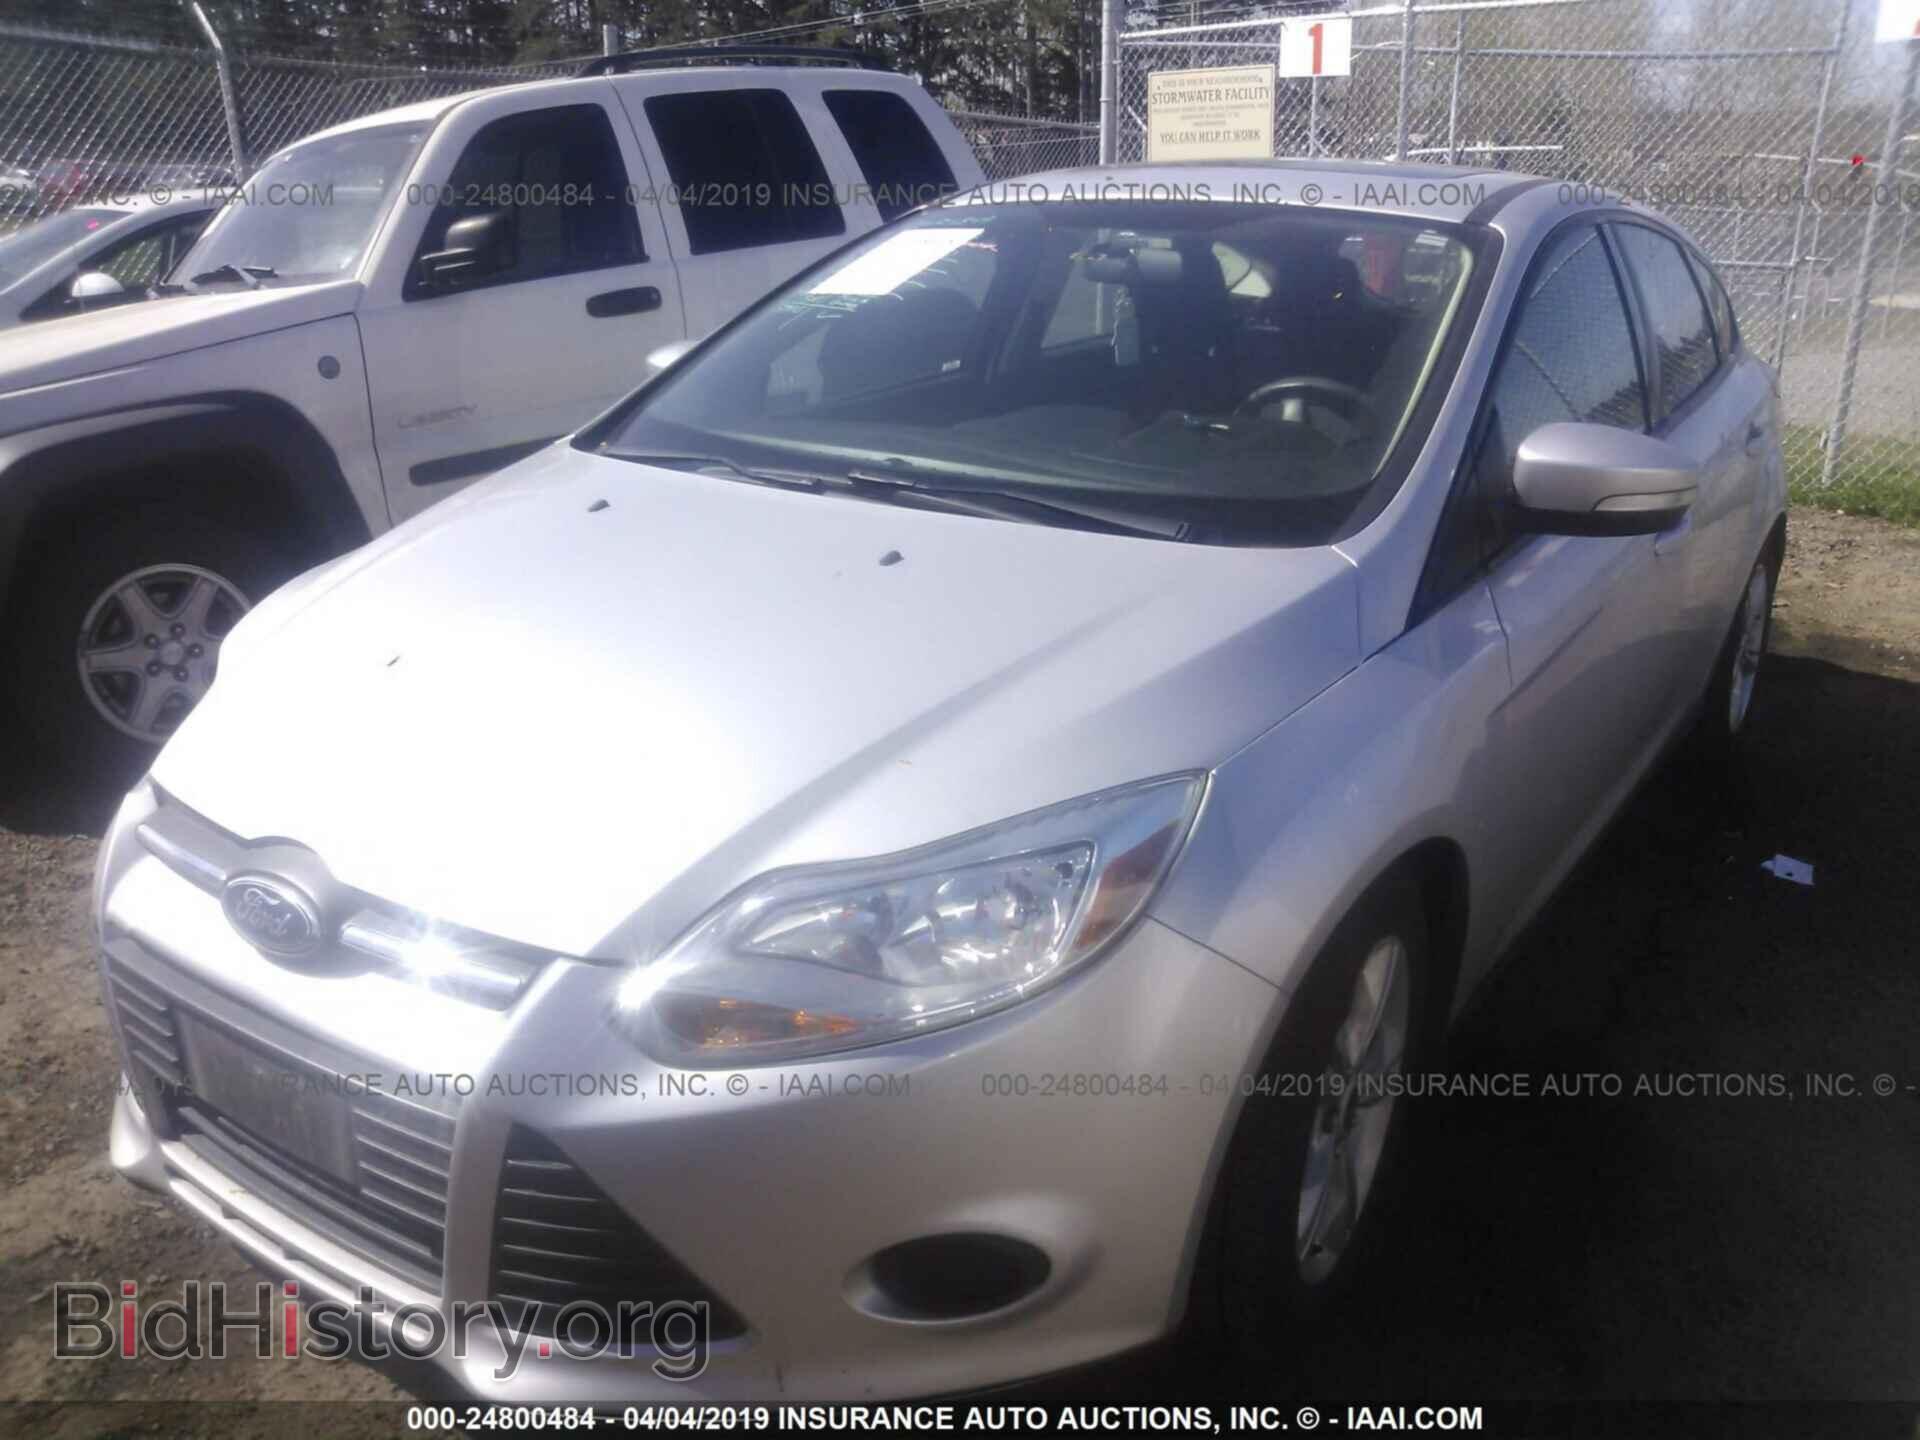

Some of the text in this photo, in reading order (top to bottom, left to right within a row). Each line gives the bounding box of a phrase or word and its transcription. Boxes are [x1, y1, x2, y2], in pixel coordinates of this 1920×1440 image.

[1308, 23, 1323, 75] 1
[1151, 86, 1269, 105] STORMWATER FACILITY
